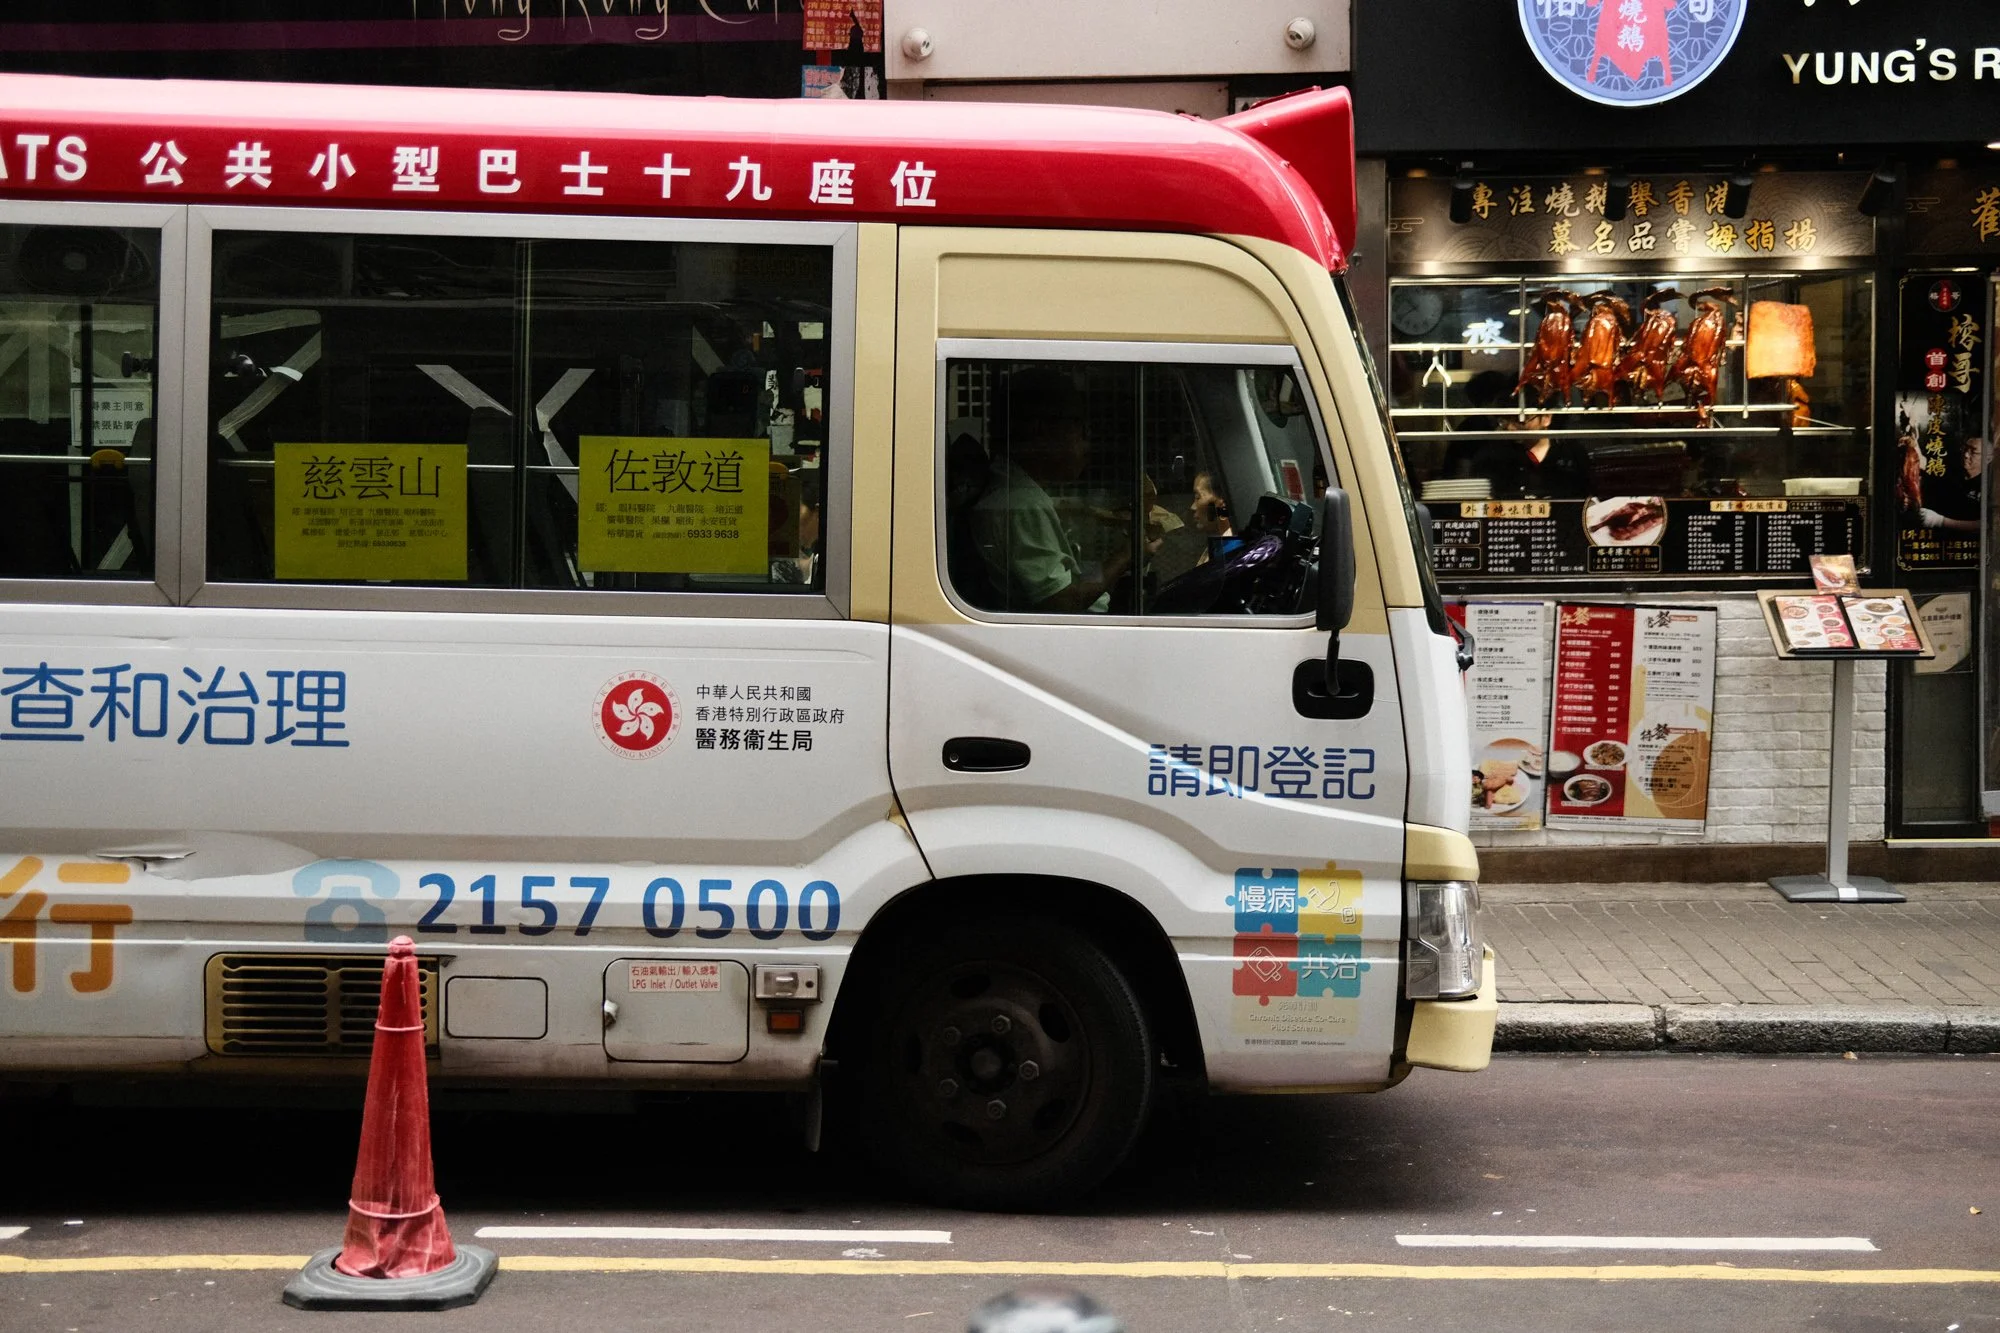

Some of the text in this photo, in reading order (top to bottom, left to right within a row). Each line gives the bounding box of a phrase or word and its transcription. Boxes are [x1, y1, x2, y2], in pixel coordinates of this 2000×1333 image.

[1782, 39, 1957, 85] YUNG'S
[140, 138, 938, 208] 公共小型巴士十九座位
[1926, 351, 1947, 388] 首創
[1948, 314, 1982, 393] 榕哥
[301, 456, 441, 500] 慈雲山
[604, 449, 744, 493] 佐敦道
[687, 529, 712, 539] 6933
[714, 529, 739, 539] 9638
[0, 661, 350, 748] 查和治理
[696, 685, 812, 701] 中華人民共和國
[696, 706, 845, 724] 香港特別行政區政府
[609, 743, 664, 758] HONG KONG
[1148, 743, 1375, 799] 請即登記
[417, 872, 841, 941] 2157 0500
[1238, 884, 1296, 914] 慢病
[0, 856, 134, 993] 行
[632, 979, 647, 989] LPG
[650, 979, 666, 989] Inlet
[674, 979, 698, 989] Outlet
[700, 979, 718, 989] Valve
[1302, 953, 1358, 980] 共治
